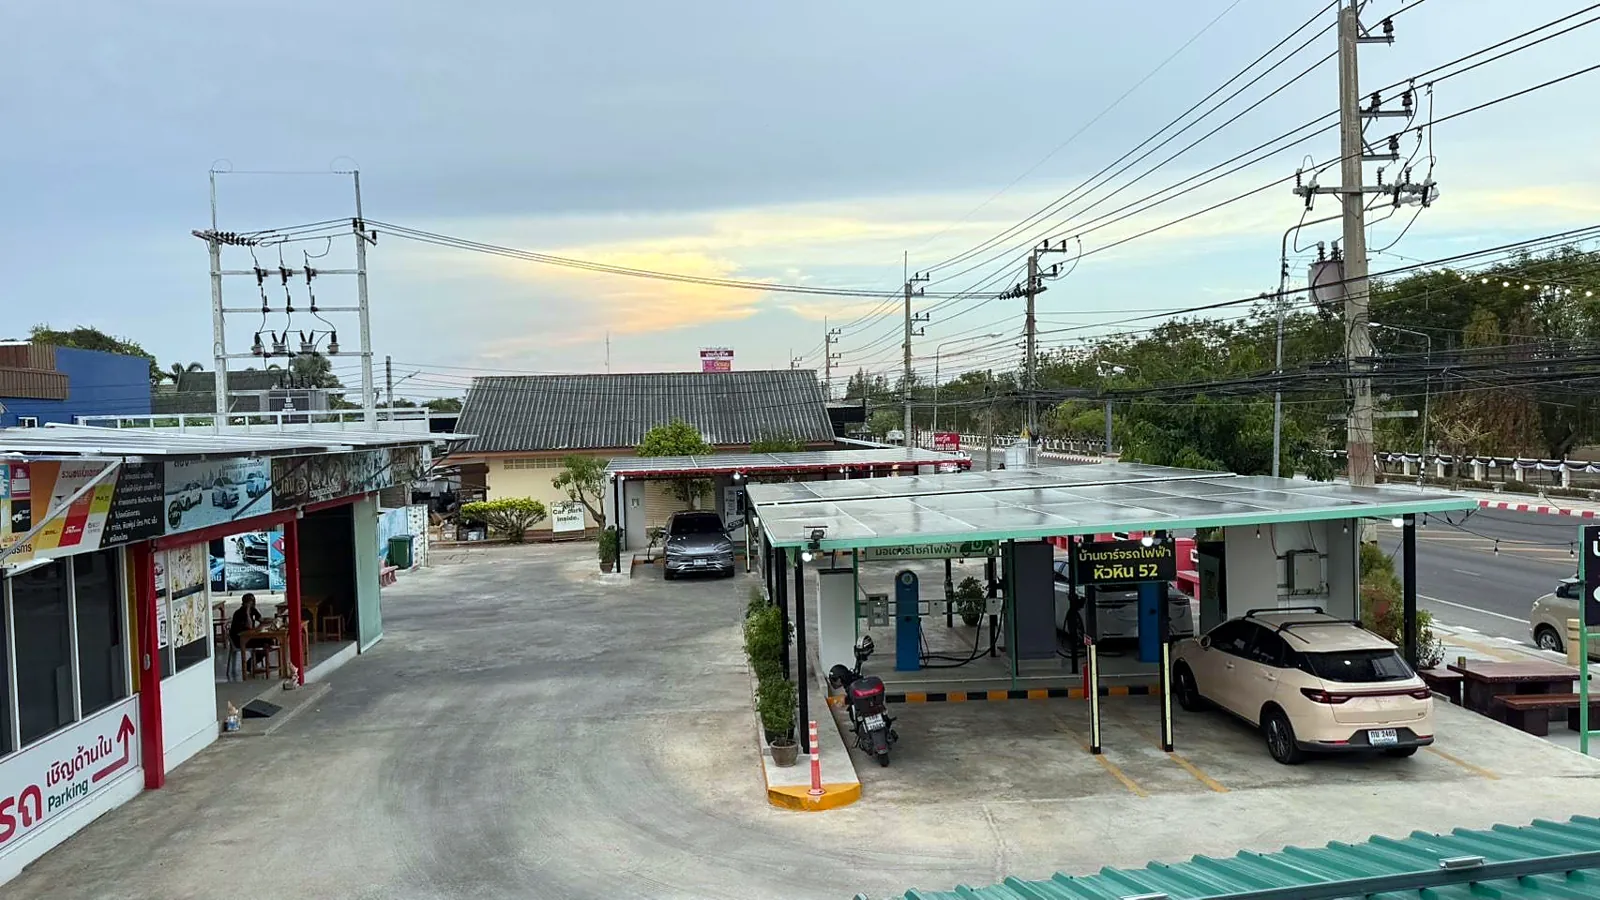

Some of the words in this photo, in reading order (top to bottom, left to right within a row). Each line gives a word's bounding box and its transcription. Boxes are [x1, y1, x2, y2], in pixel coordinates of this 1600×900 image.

[1079, 545, 1172, 561] บ้านชาร์จรถไฟฟ้า
[1093, 564, 1134, 579] หัวหิน
[1139, 564, 1158, 577] 52
[46, 735, 113, 787] เชิญด้านใน
[47, 779, 89, 812] Parking
